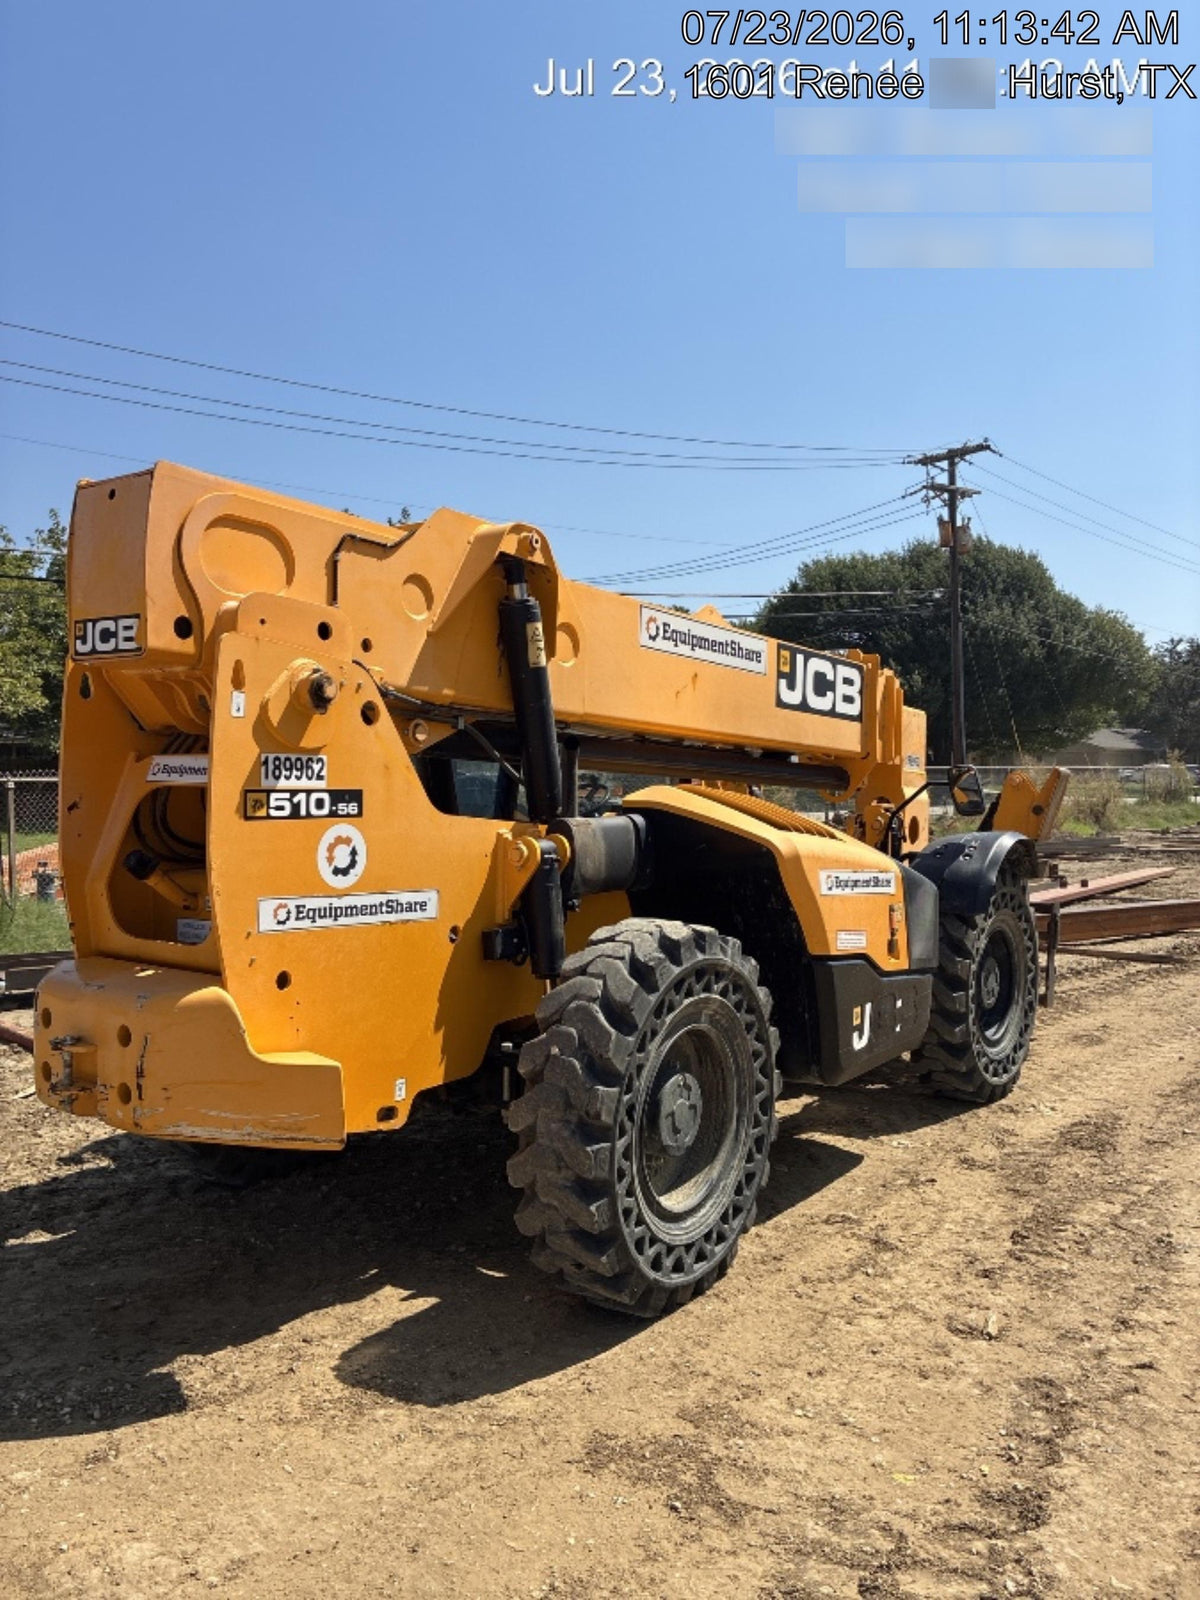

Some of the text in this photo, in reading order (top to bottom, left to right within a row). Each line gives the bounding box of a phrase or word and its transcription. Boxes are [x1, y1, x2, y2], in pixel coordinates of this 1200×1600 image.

[662, 621, 762, 663] EquipmentShare
[778, 653, 862, 716] JCB
[161, 763, 209, 777] Equipmen
[261, 755, 326, 781] 189962
[268, 792, 359, 817] 510-56
[294, 899, 428, 923] EquipmentShare
